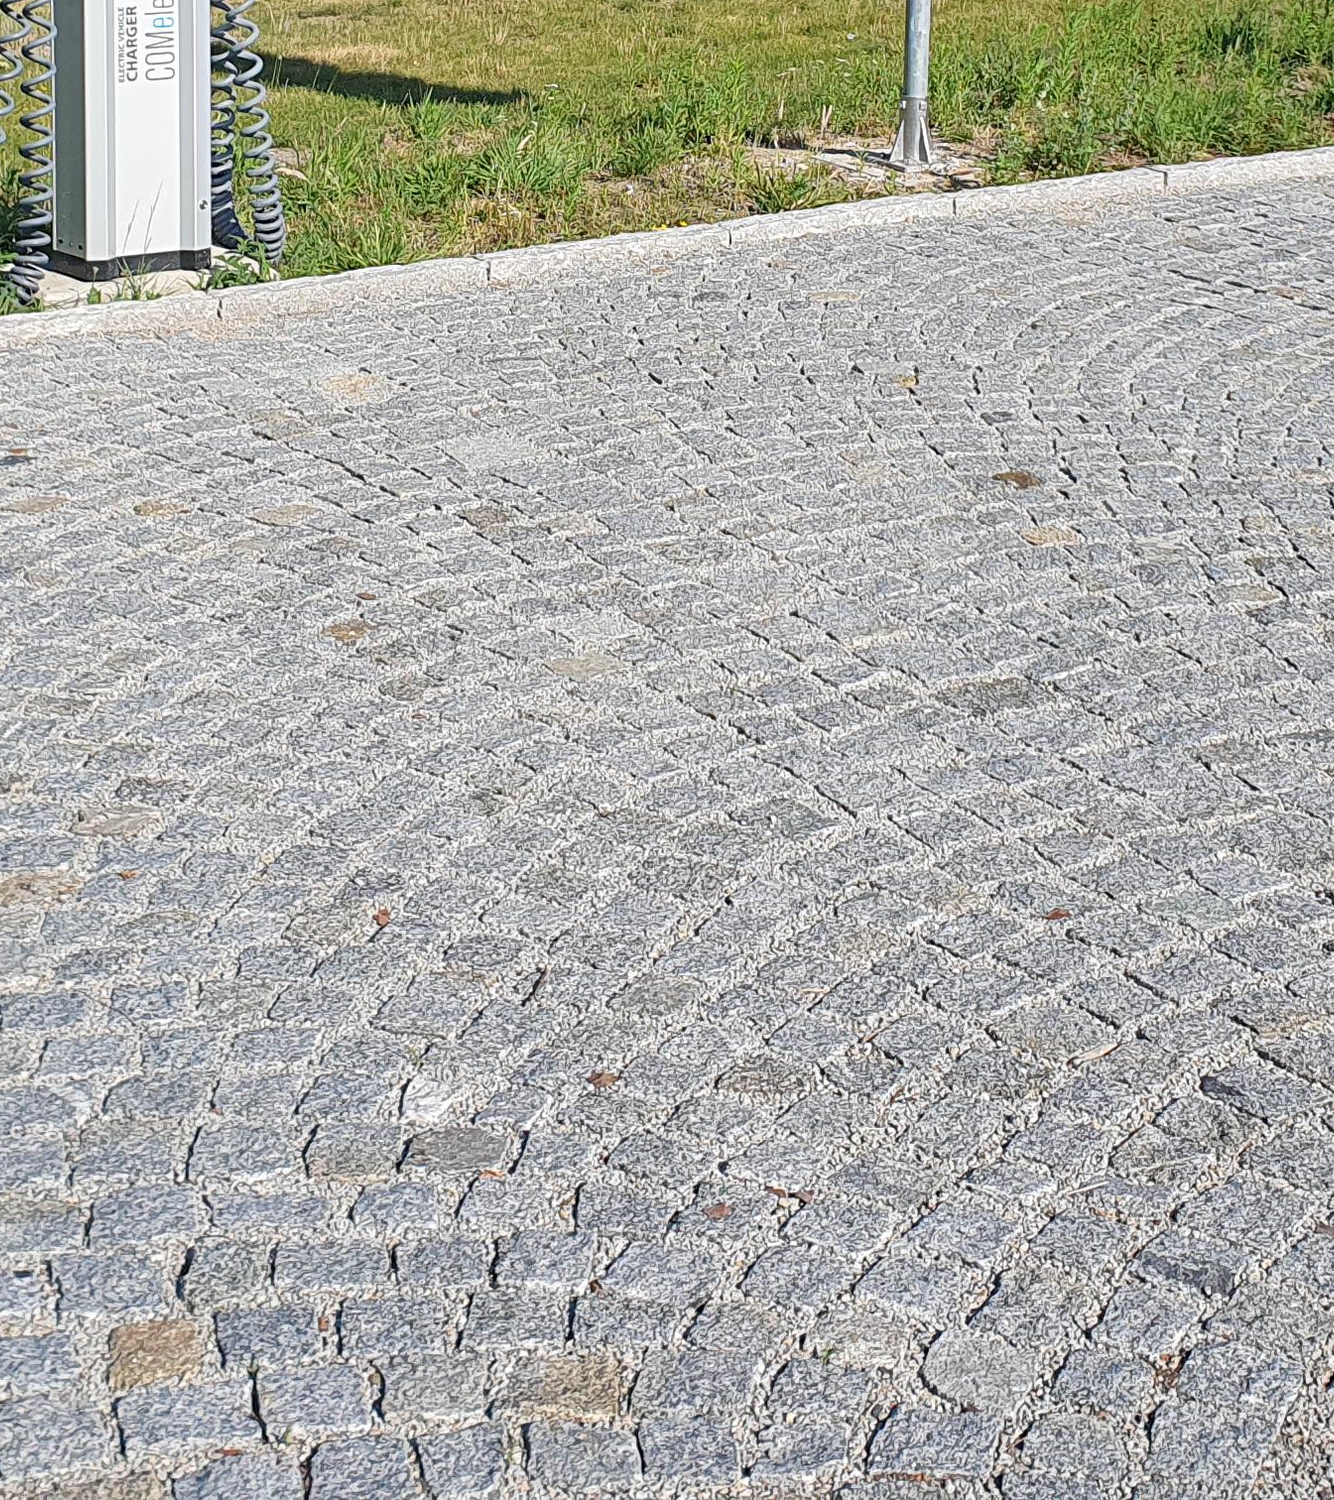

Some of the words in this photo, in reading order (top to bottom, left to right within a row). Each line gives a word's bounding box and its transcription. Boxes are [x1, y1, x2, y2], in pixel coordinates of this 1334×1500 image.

[117, 6, 125, 42] VEHICLE
[126, 5, 138, 82] CHARGER
[117, 44, 125, 83] ELECTRIC
